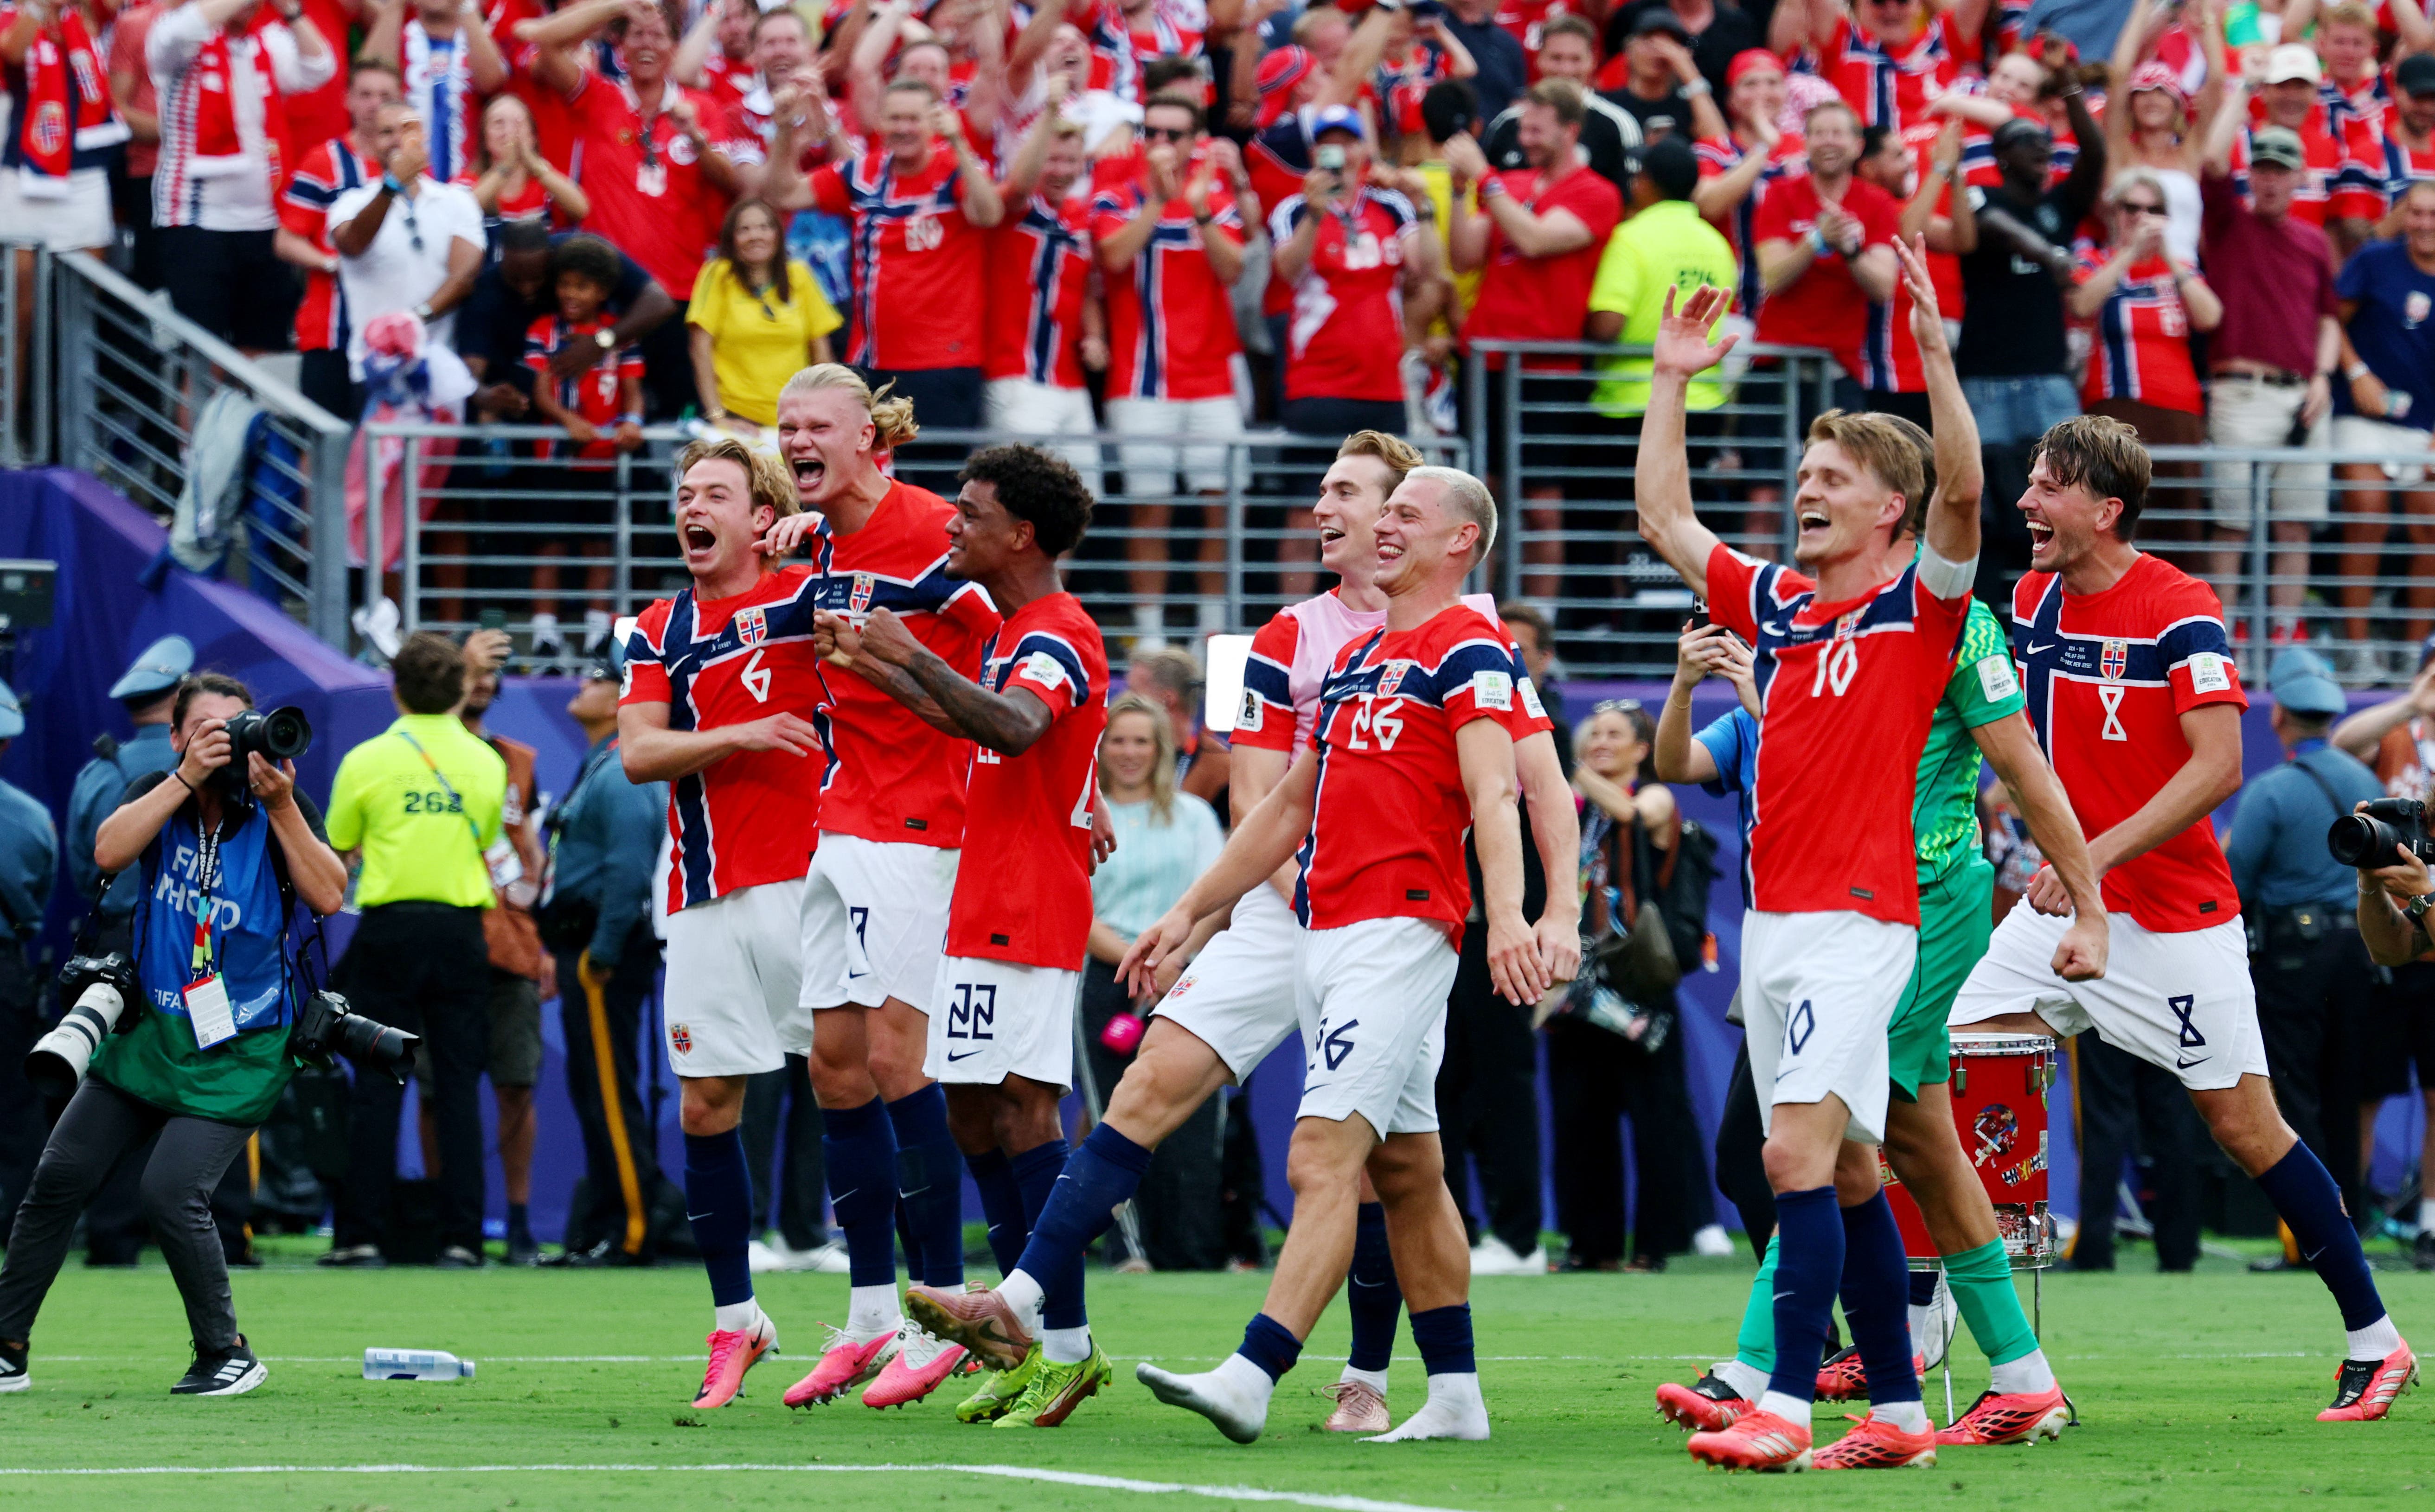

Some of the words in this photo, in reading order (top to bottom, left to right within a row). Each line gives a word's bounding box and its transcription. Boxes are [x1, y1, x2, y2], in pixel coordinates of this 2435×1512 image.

[740, 648, 772, 703] 6
[1812, 638, 1858, 697] 10
[1348, 694, 1404, 751] 26
[2098, 685, 2127, 741] 8
[947, 983, 997, 1040] 22
[2168, 994, 2206, 1048] 8
